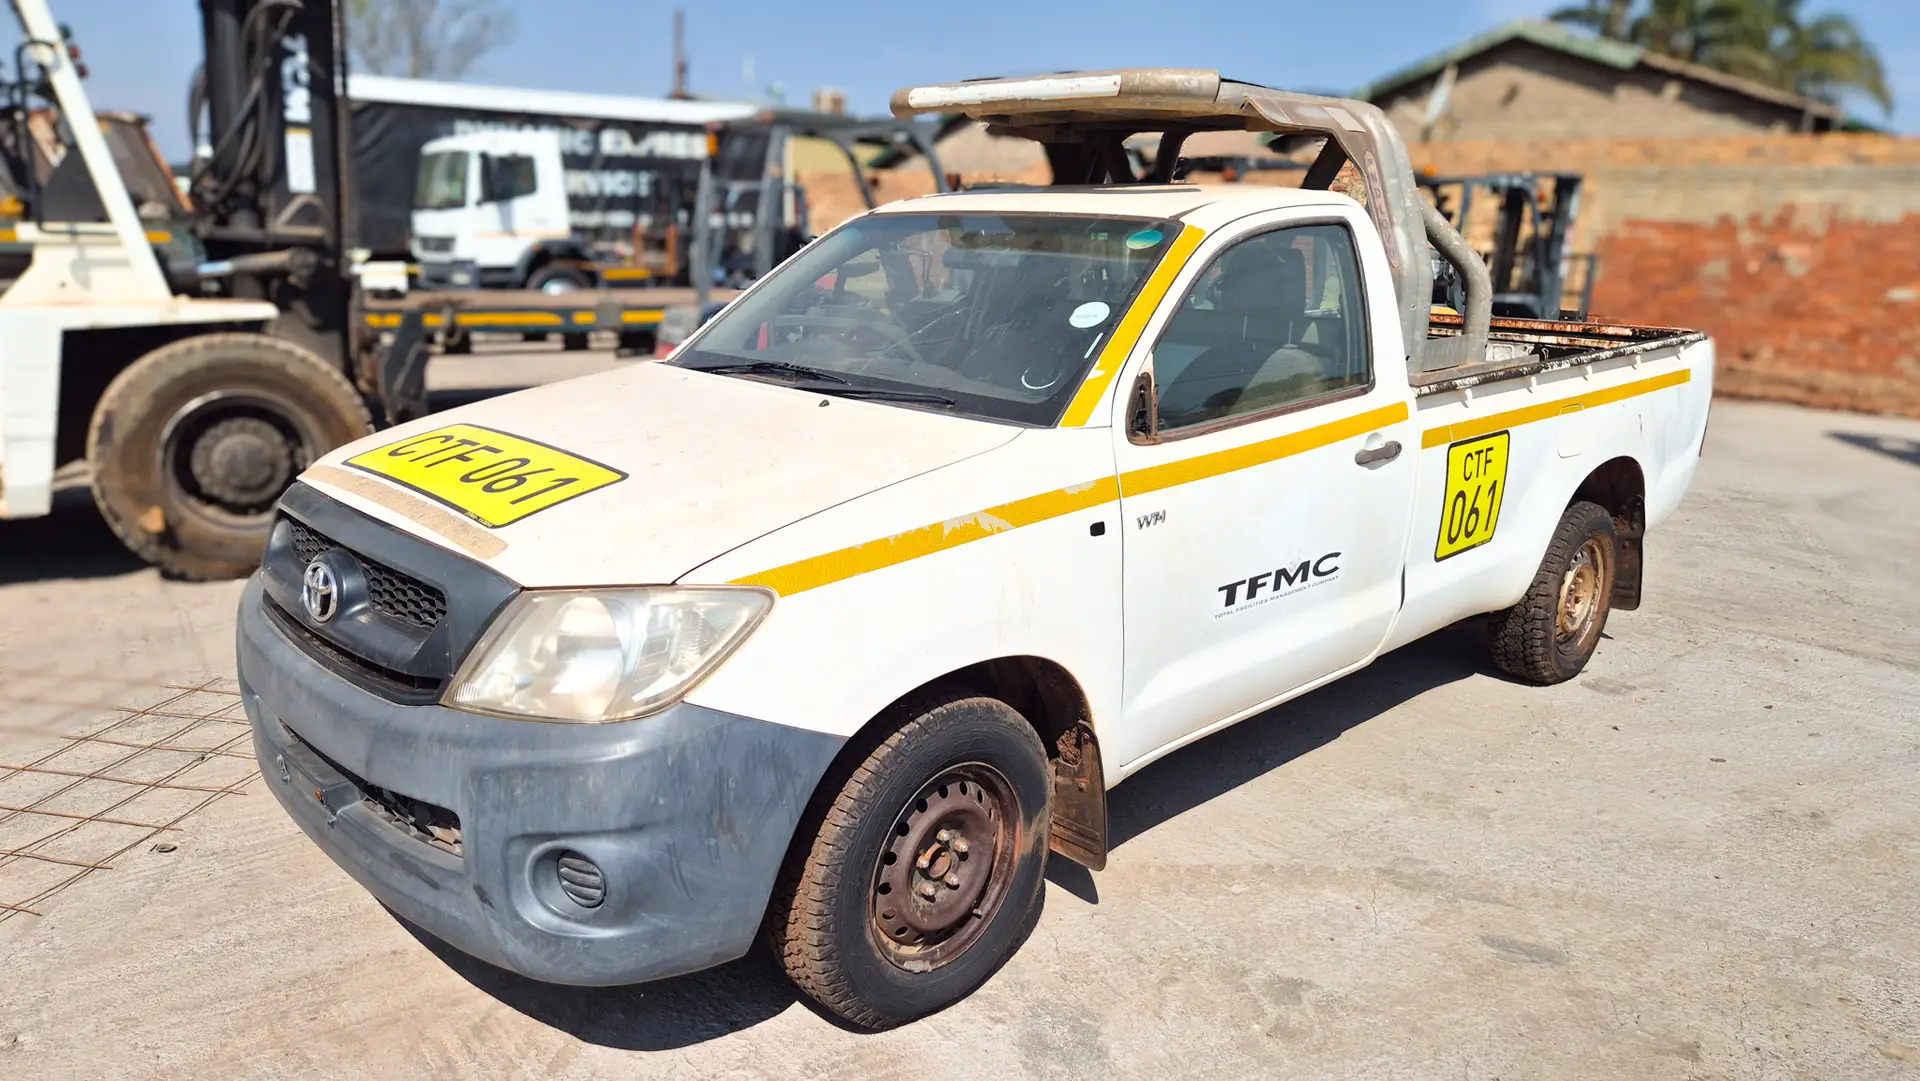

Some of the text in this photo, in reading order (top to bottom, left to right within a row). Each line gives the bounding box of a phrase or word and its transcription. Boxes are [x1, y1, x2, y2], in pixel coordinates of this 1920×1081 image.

[1463, 446, 1494, 481] CTF
[1447, 479, 1498, 545] 061
[1214, 575, 1340, 620] TOTAL FACILITIES MANAGEMENT COMPANY
[1218, 551, 1342, 608] TFMC
